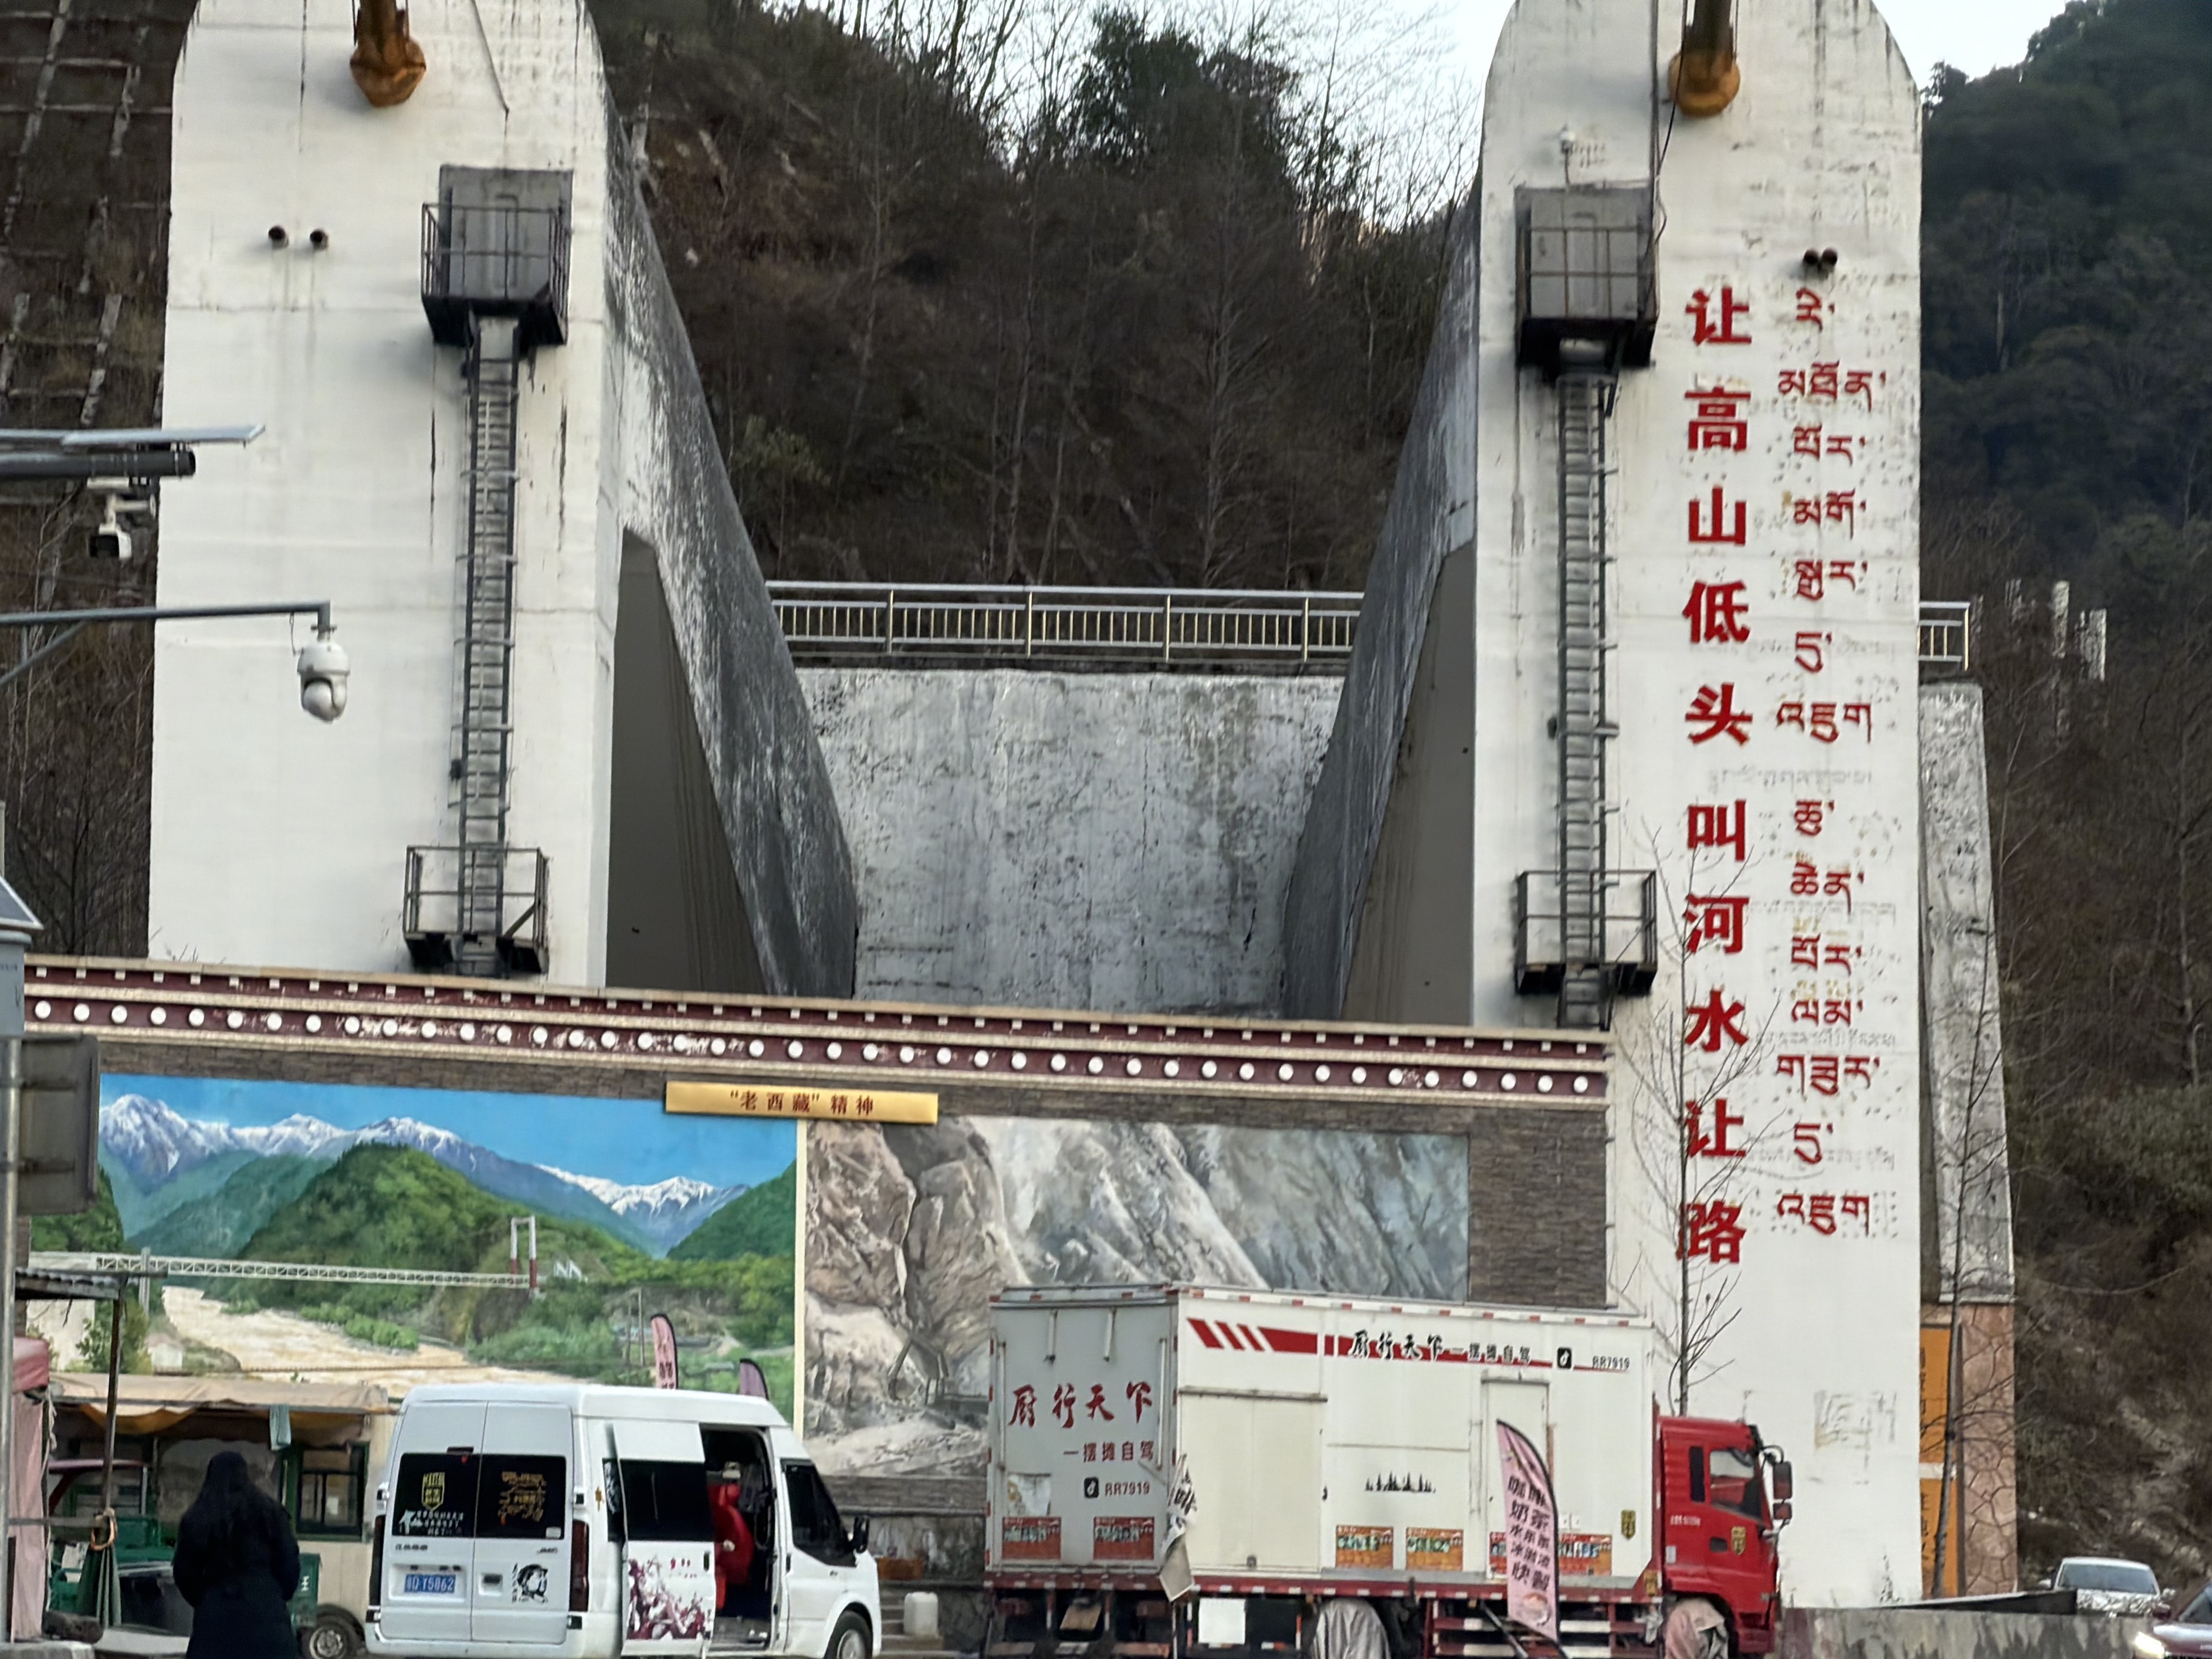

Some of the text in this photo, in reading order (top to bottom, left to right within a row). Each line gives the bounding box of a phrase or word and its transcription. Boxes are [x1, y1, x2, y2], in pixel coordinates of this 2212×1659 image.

[1677, 286, 1753, 1264] 让高山低头叫河水让路
[1592, 1355, 1630, 1370] RR7919
[1105, 1480, 1151, 1497] RR7919
